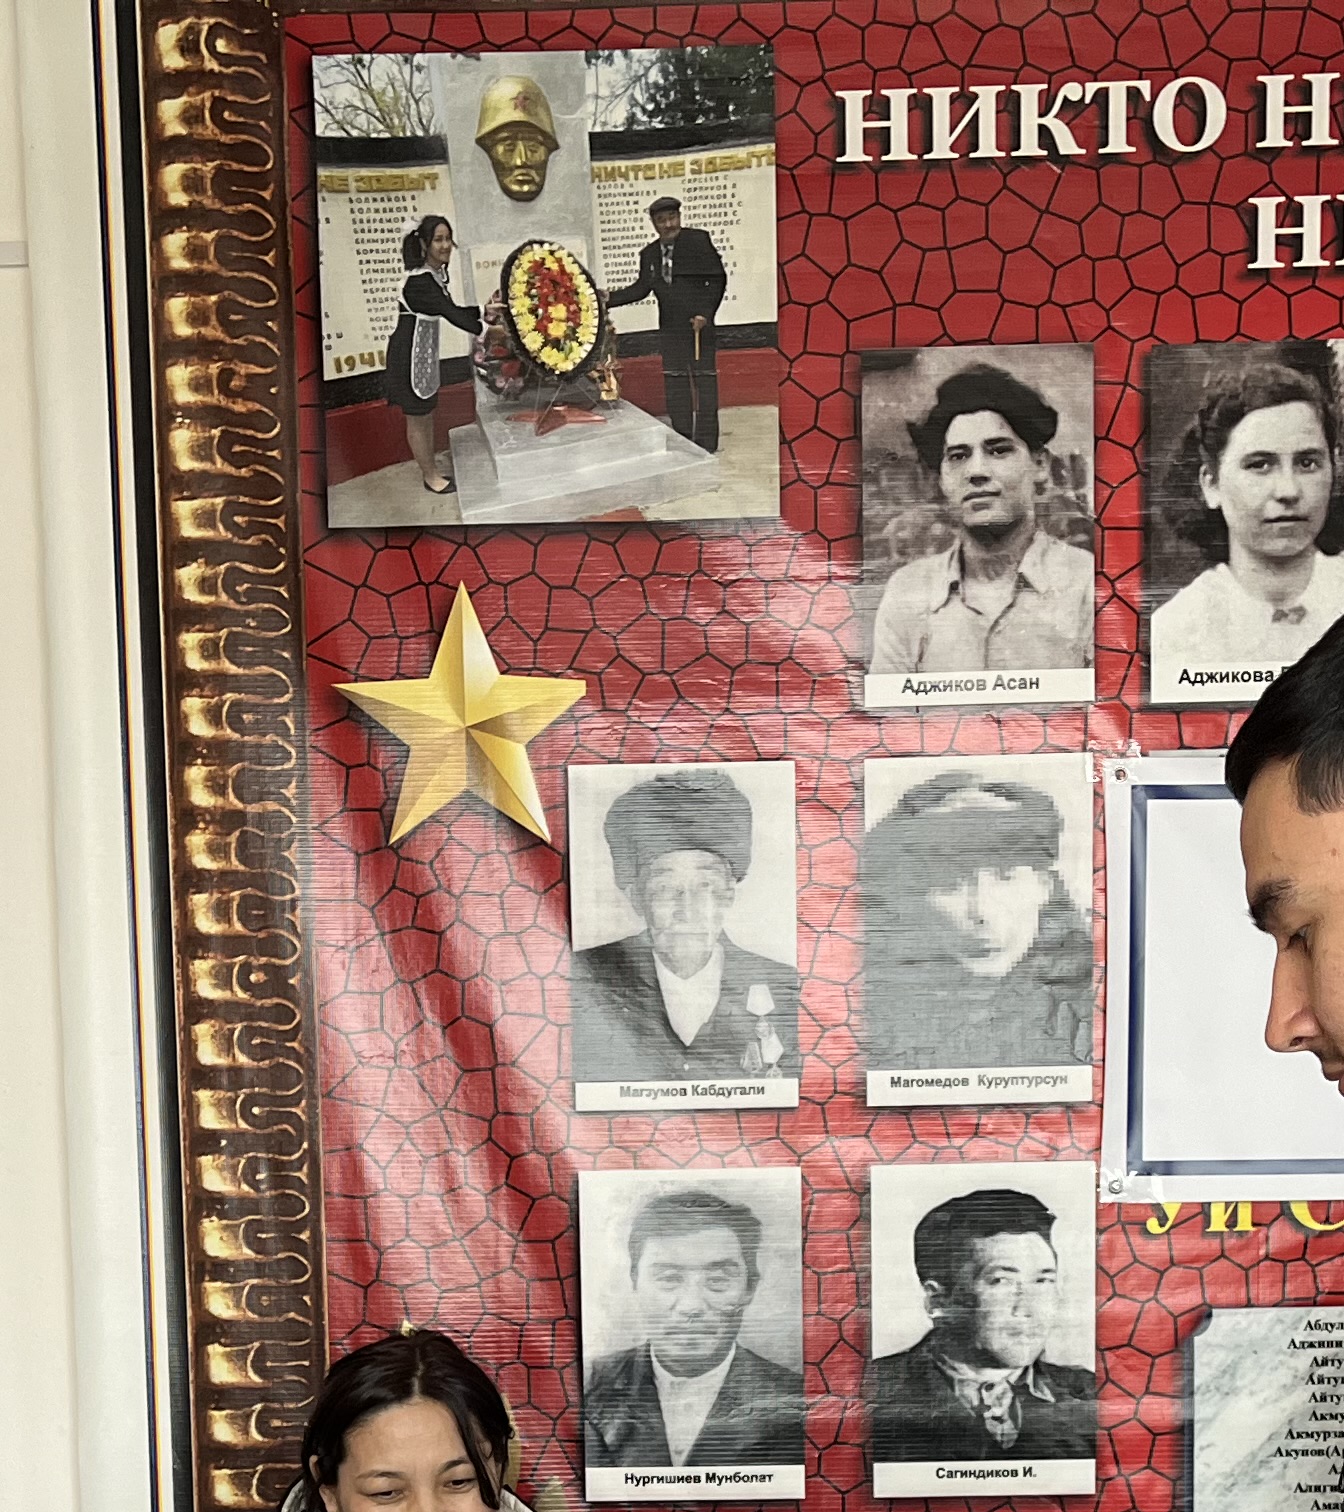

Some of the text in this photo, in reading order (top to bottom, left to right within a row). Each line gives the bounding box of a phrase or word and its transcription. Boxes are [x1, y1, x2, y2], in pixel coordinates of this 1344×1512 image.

[835, 76, 1227, 163] НИКТО
[901, 675, 1041, 696] Аджиков Асан
[1178, 667, 1274, 687] Аджикова
[890, 1075, 970, 1089] Магомедов
[691, 1084, 766, 1099] Кабдугали
[624, 1471, 774, 1488] Нургишиев Мунболат
[935, 1466, 1038, 1481] Сагиндиков И.
